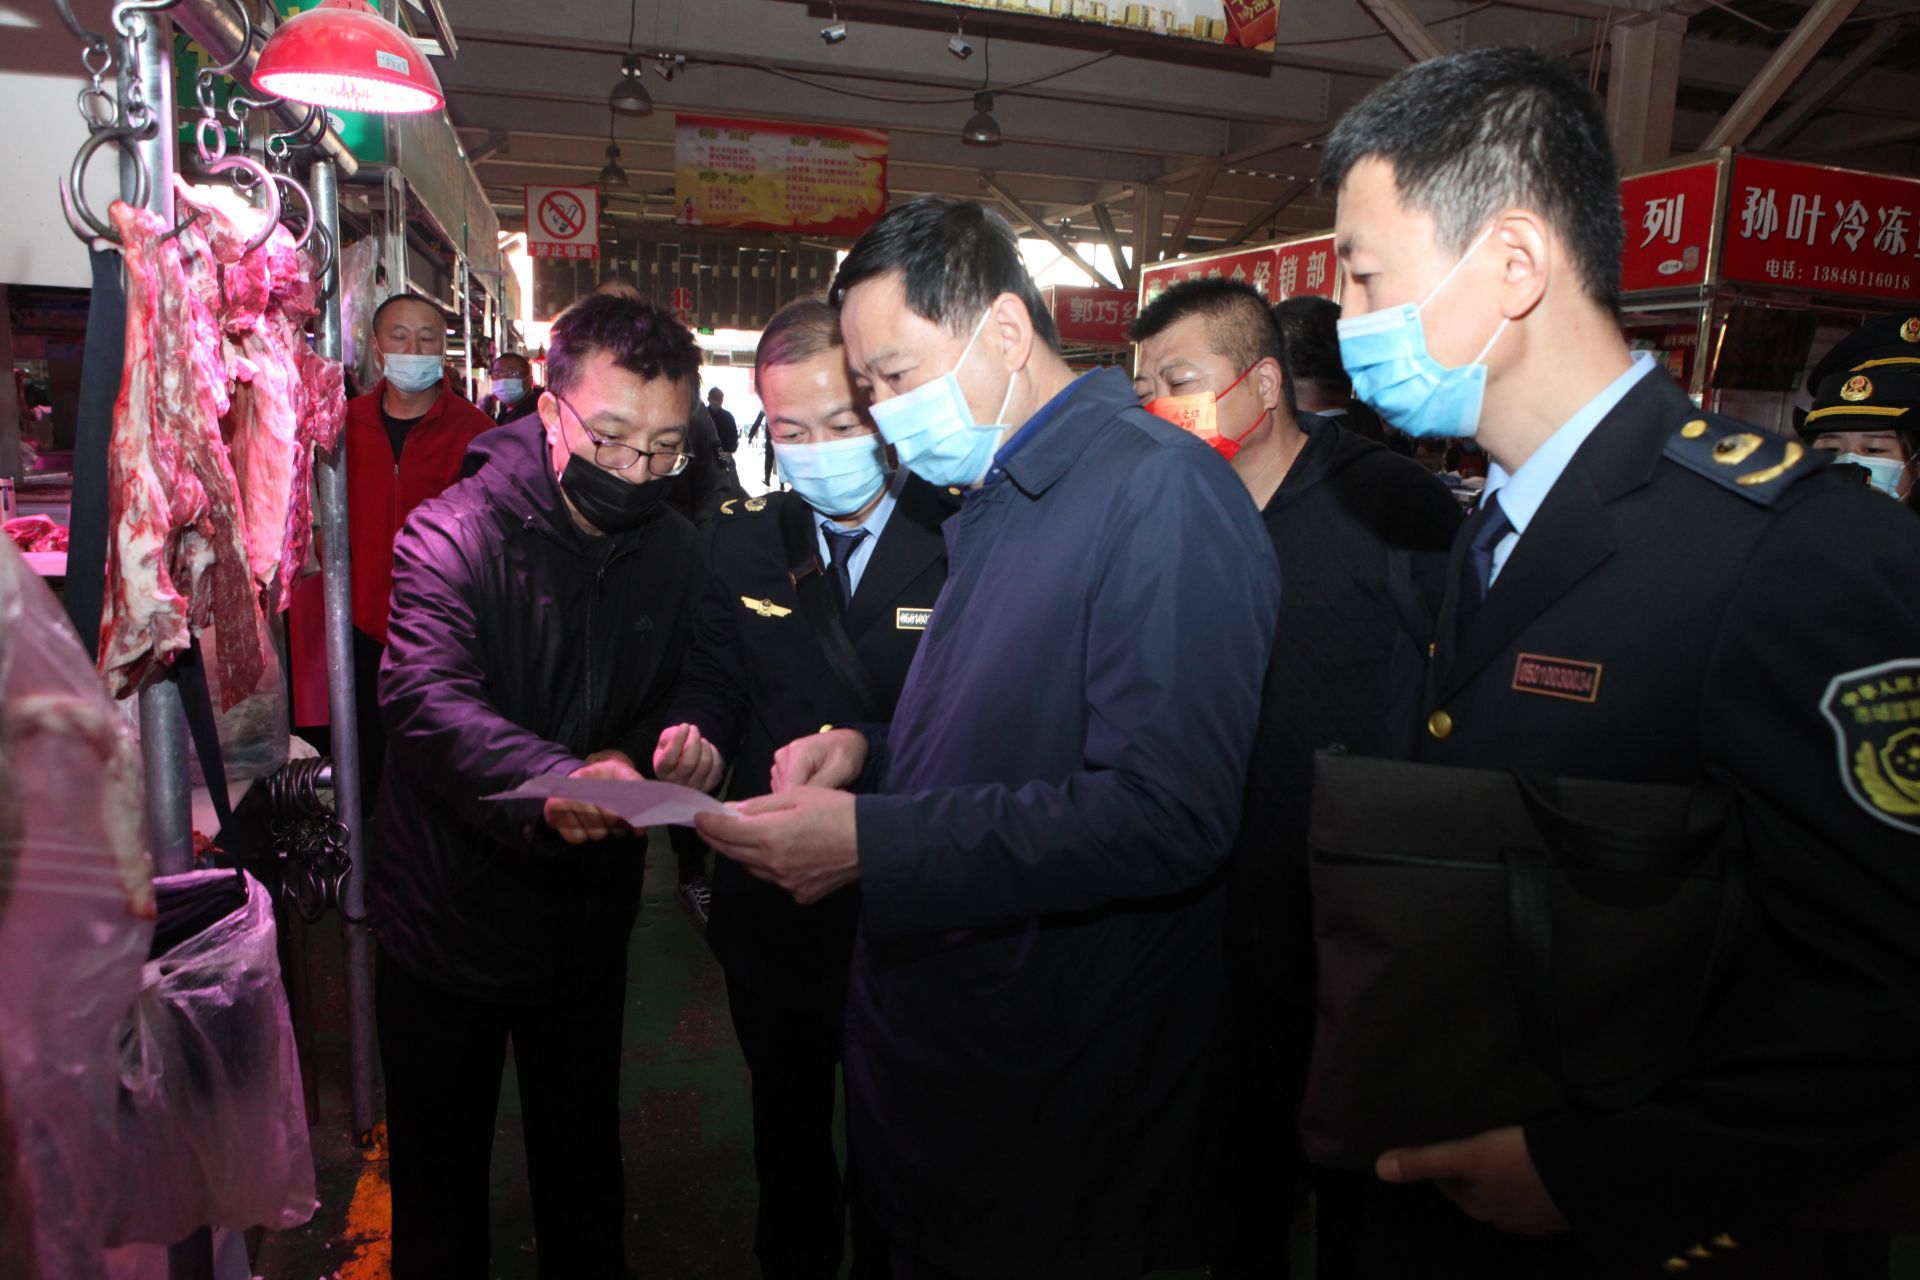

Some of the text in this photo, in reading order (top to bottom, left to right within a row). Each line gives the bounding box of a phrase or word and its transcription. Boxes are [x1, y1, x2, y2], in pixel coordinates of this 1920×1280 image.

[1640, 193, 1685, 248] 列
[1740, 186, 1920, 258] 孙叶冷冻
[536, 244, 593, 258] 禁止吸烟
